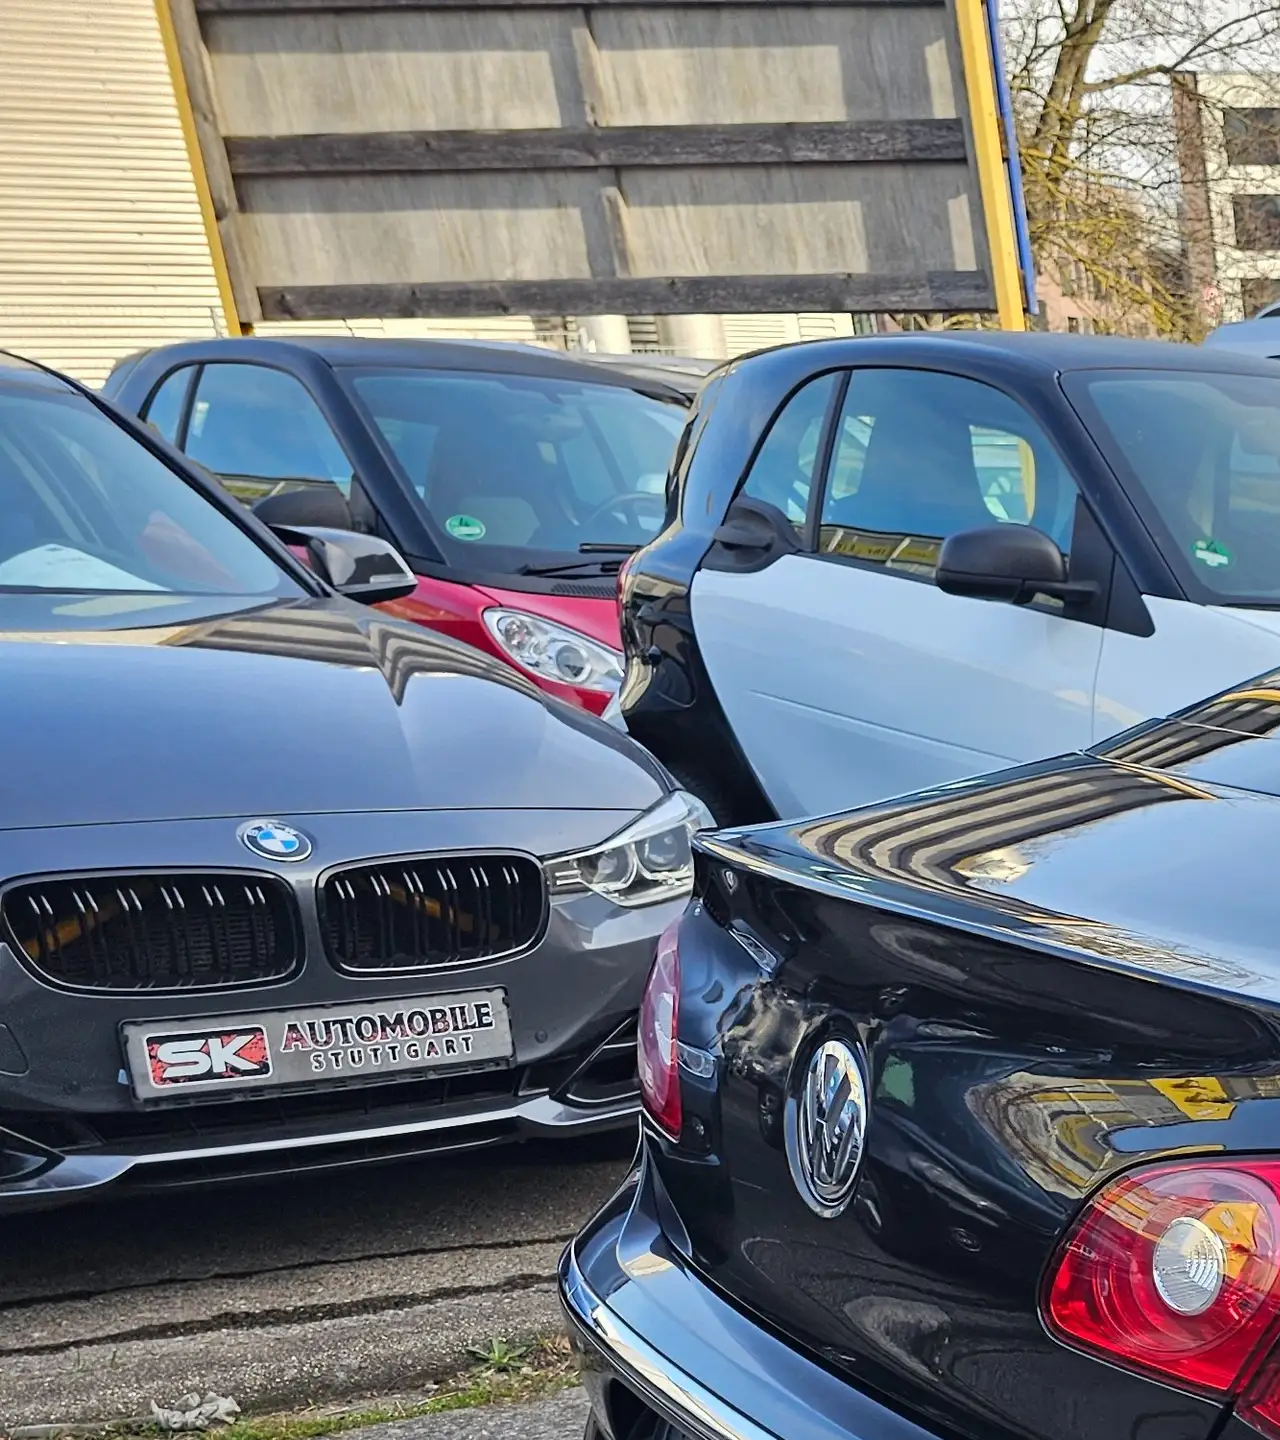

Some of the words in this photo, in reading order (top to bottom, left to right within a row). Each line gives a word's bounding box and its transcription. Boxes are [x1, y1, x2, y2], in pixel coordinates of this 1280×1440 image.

[282, 1002, 494, 1053] AUTOMOBILE
[158, 1034, 259, 1079] SK
[311, 1036, 474, 1072] STUTTGART
